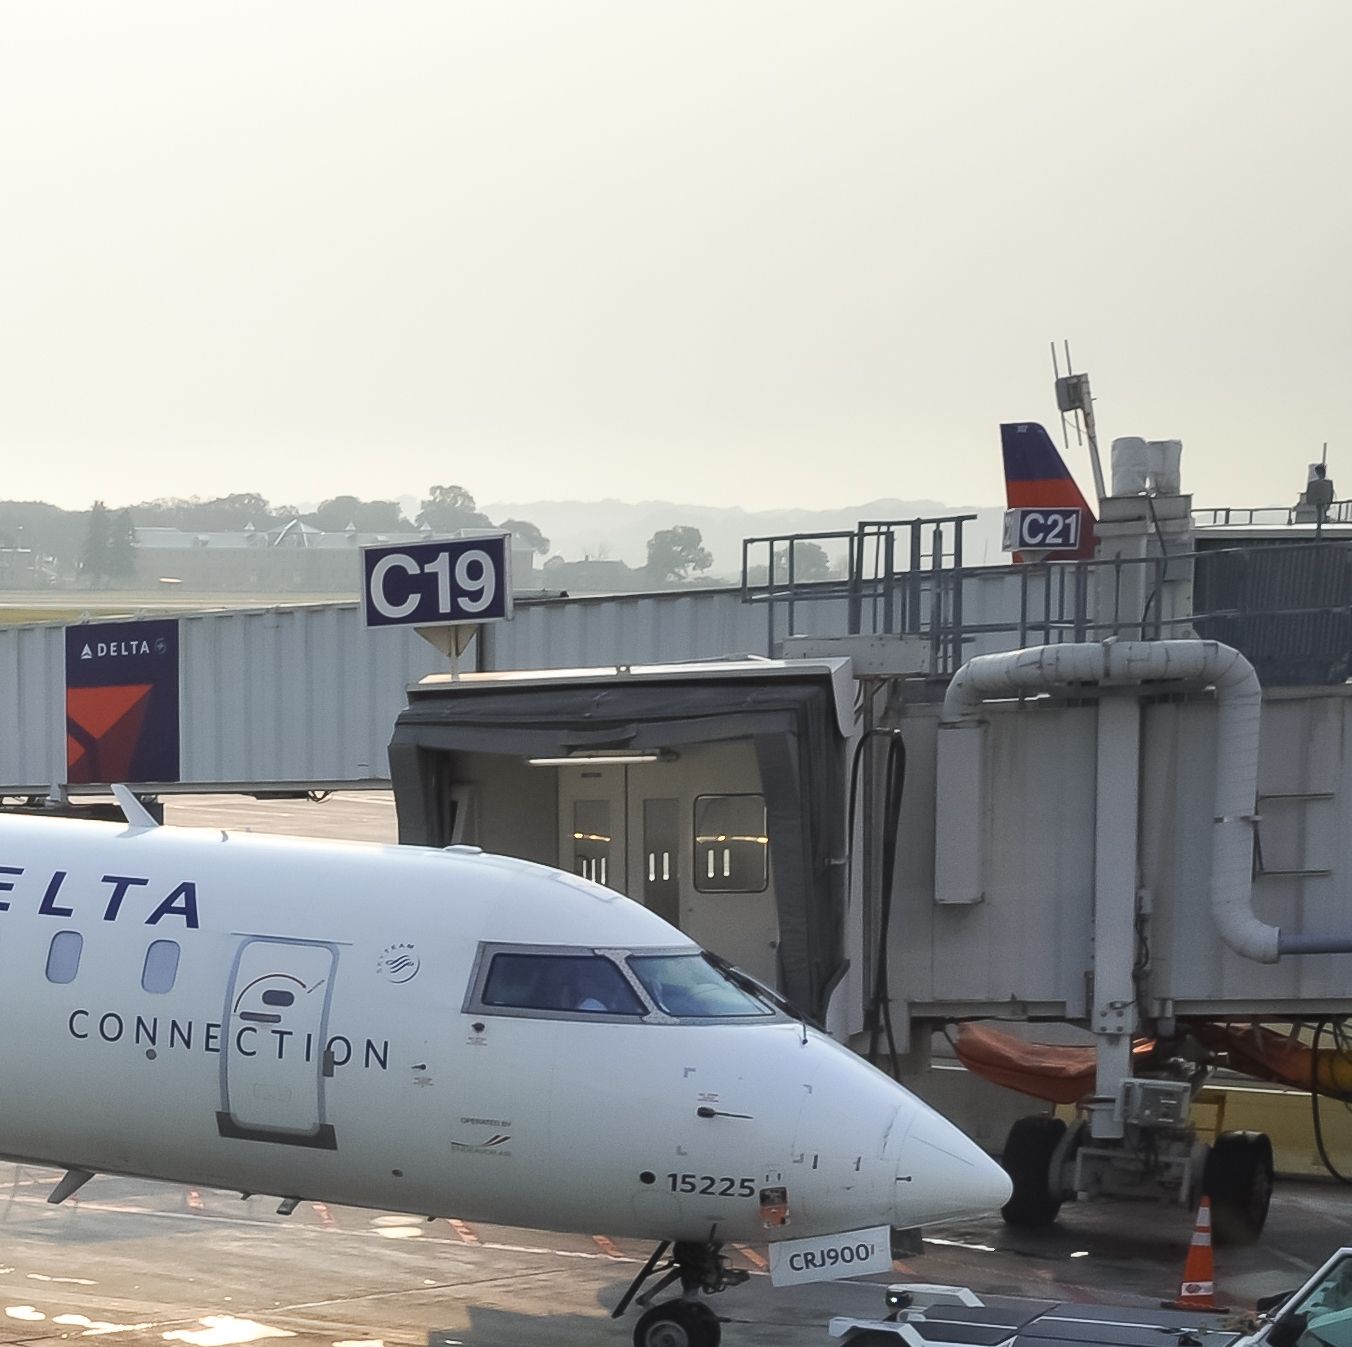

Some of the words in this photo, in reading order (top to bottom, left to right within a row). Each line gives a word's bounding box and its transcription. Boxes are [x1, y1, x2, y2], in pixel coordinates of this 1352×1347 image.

[1022, 512, 1077, 545] C21
[370, 549, 496, 618] C19
[97, 640, 150, 657] DELTA
[68, 1009, 389, 1070] CONNECTION
[667, 1173, 756, 1198] 15225
[789, 1243, 871, 1271] CRJ900
